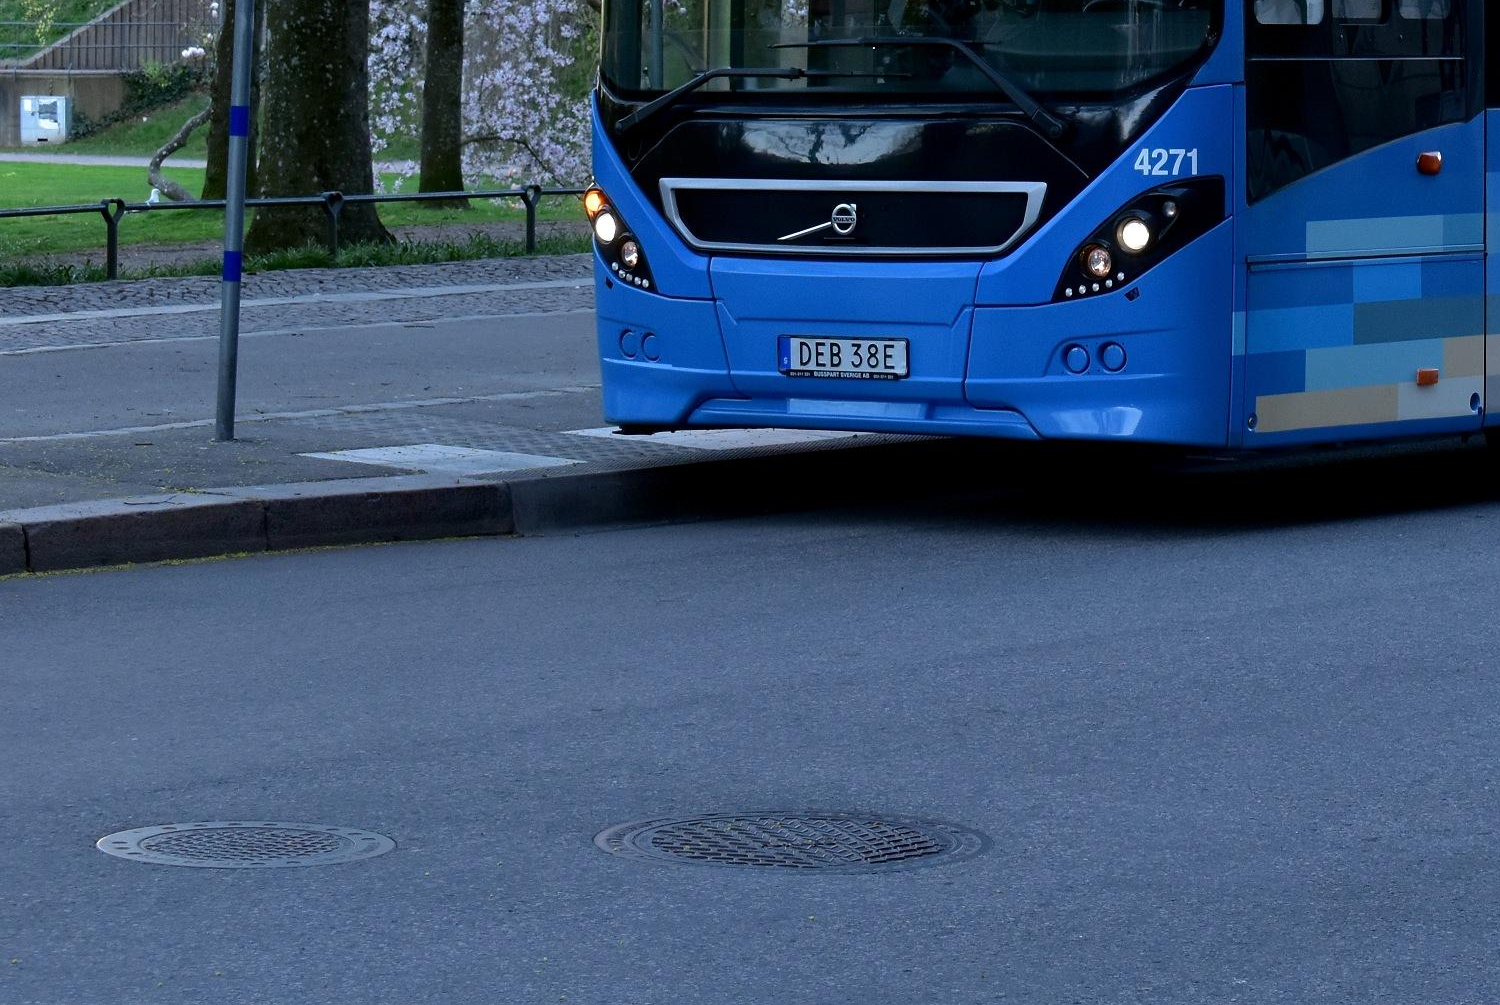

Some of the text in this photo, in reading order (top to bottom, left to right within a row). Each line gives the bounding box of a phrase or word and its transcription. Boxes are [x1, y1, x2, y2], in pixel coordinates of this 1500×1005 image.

[1134, 148, 1198, 176] 4271
[799, 341, 895, 369] DEB 38E
